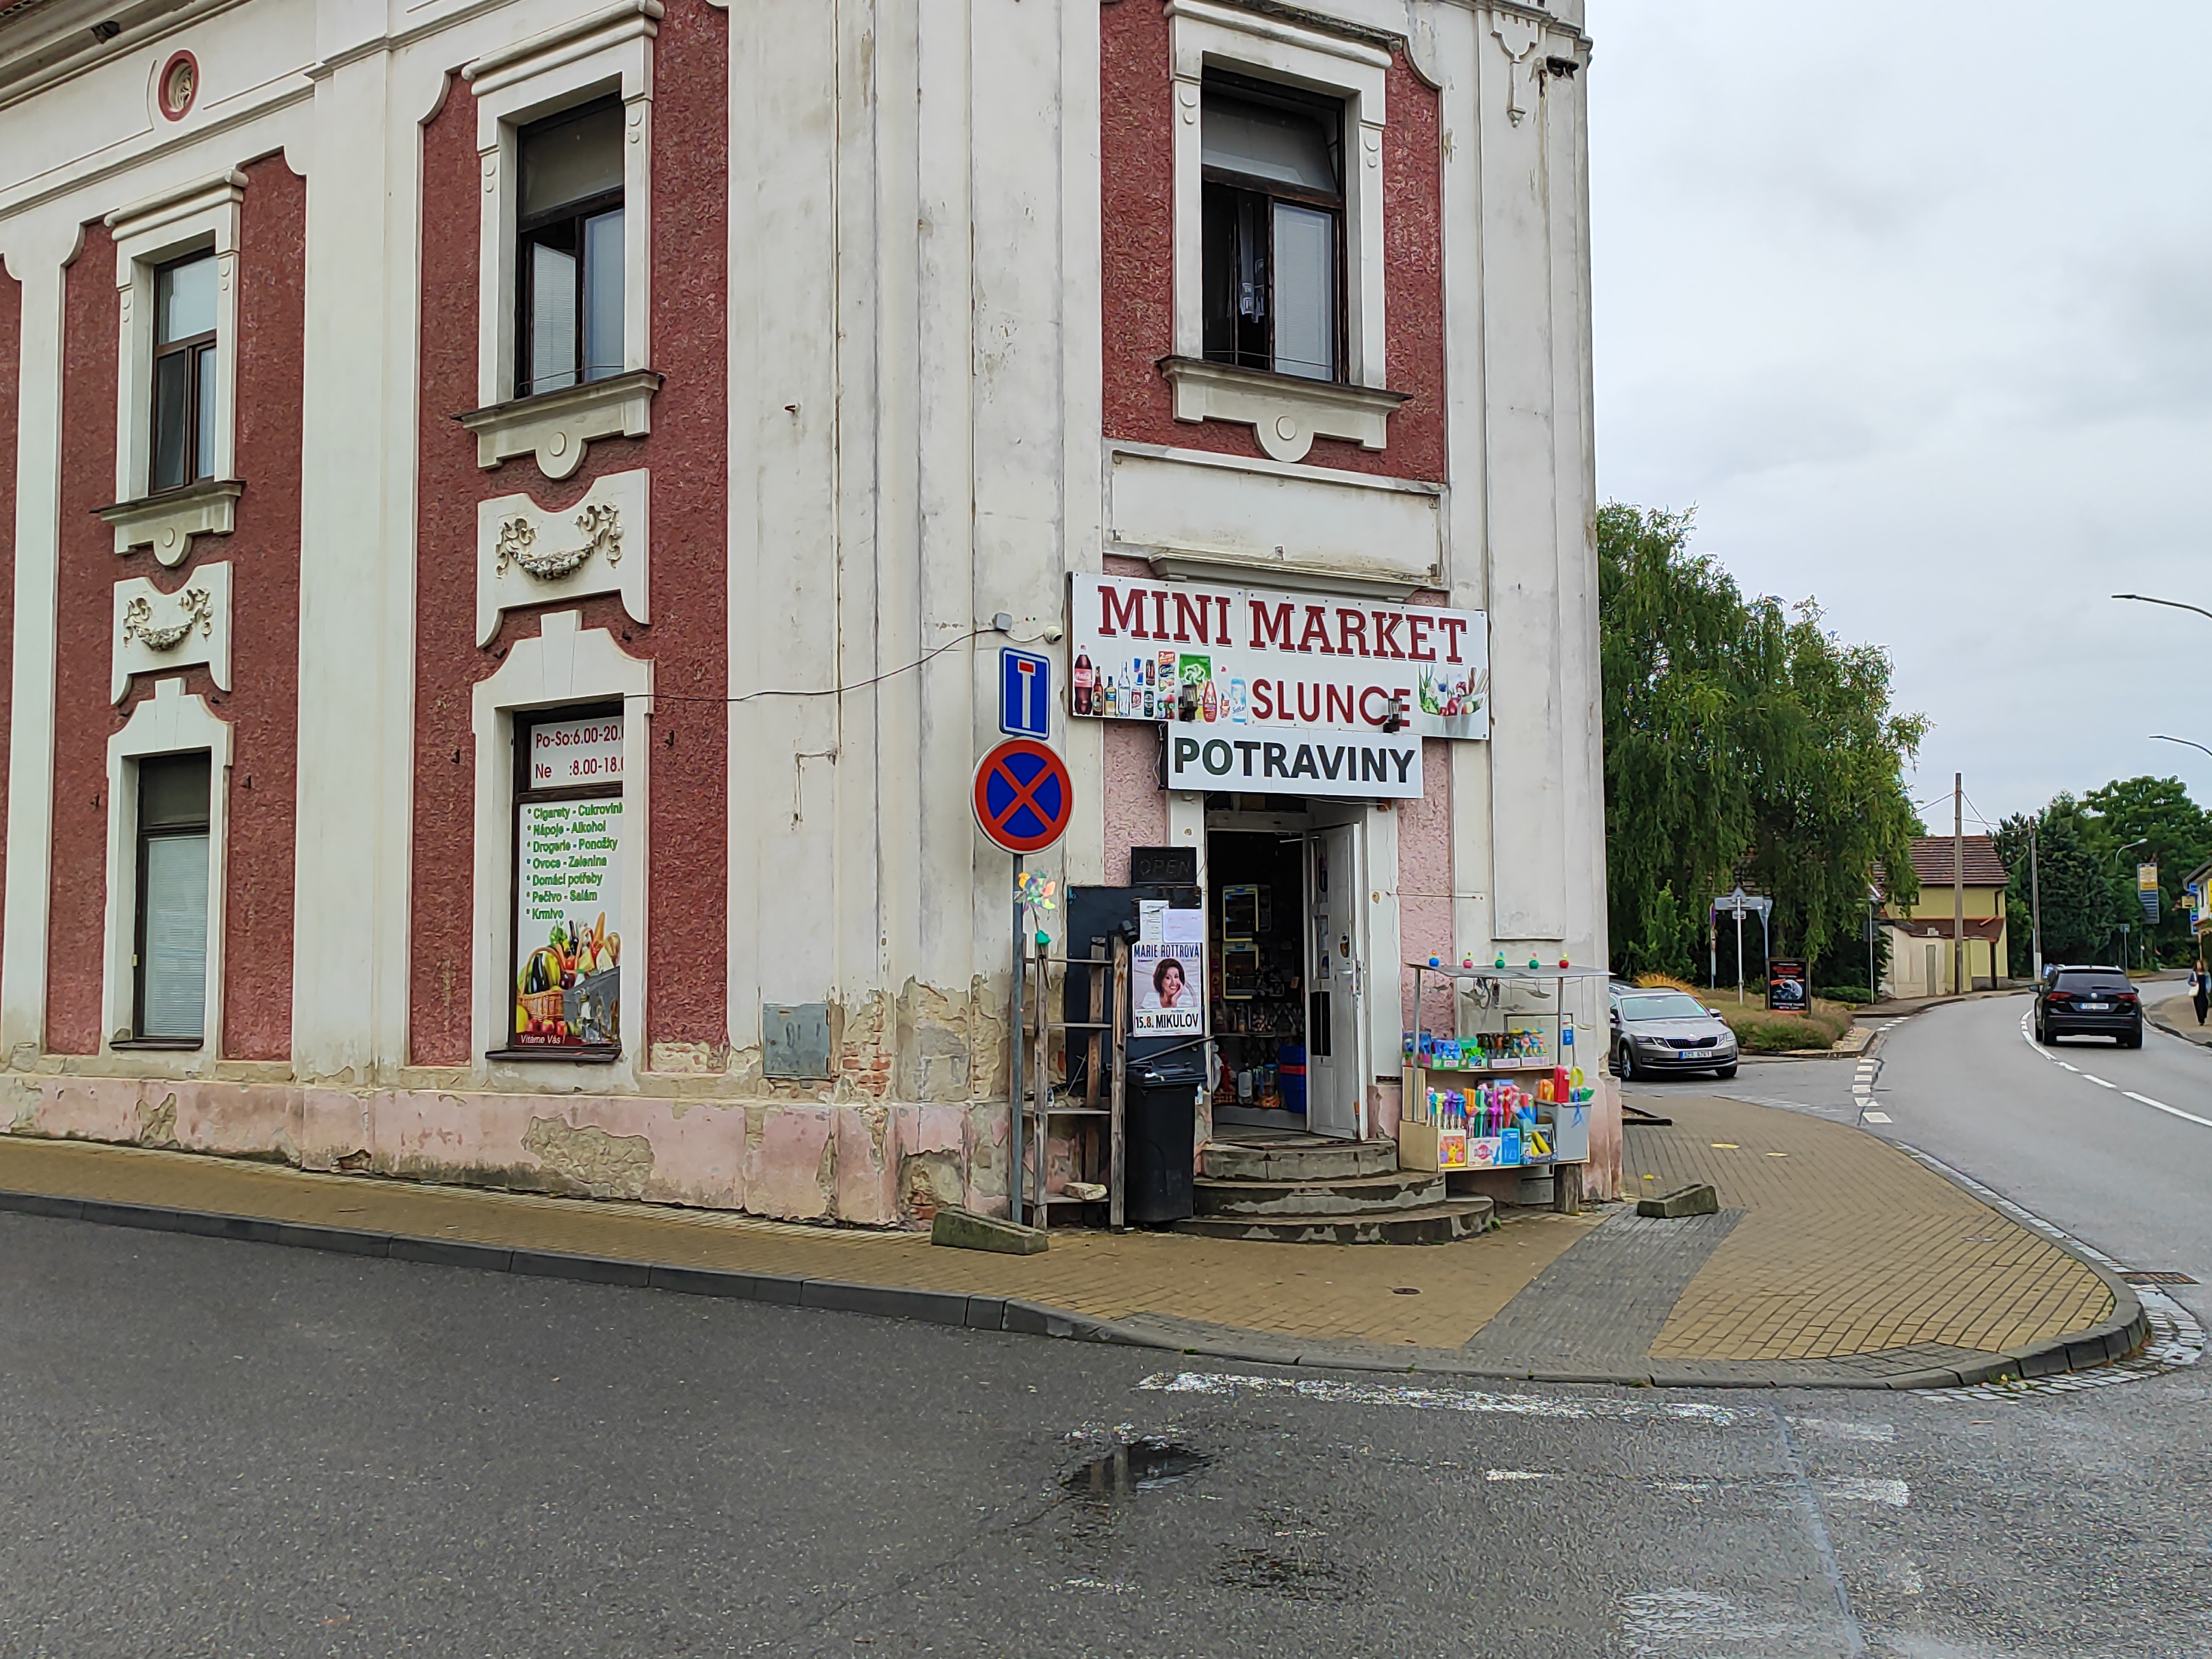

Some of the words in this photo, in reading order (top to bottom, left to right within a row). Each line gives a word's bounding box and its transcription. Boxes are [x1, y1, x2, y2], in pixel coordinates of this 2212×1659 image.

[1098, 585, 1233, 647] MINI
[1249, 599, 1467, 664] MARKET
[1174, 737, 1416, 783] POTRAVINY
[535, 763, 552, 779] Ne
[533, 807, 570, 821] Cigarety
[533, 822, 564, 837] Nápoje
[571, 820, 606, 833] Alkohol
[533, 839, 571, 854] Drogerie
[578, 837, 618, 852] Ponožky
[533, 858, 561, 870] Ovoce
[568, 854, 607, 868] Zelenina
[533, 872, 566, 886] Domácí
[568, 872, 603, 888] potřeby
[532, 890, 562, 902] Pečivo
[570, 889, 597, 901] Salám
[532, 907, 564, 920] Krmivo
[1134, 945, 1158, 957] MARIE
[1161, 943, 1199, 957] ROTTROVÁ
[1156, 1013, 1199, 1029] MIKULOV
